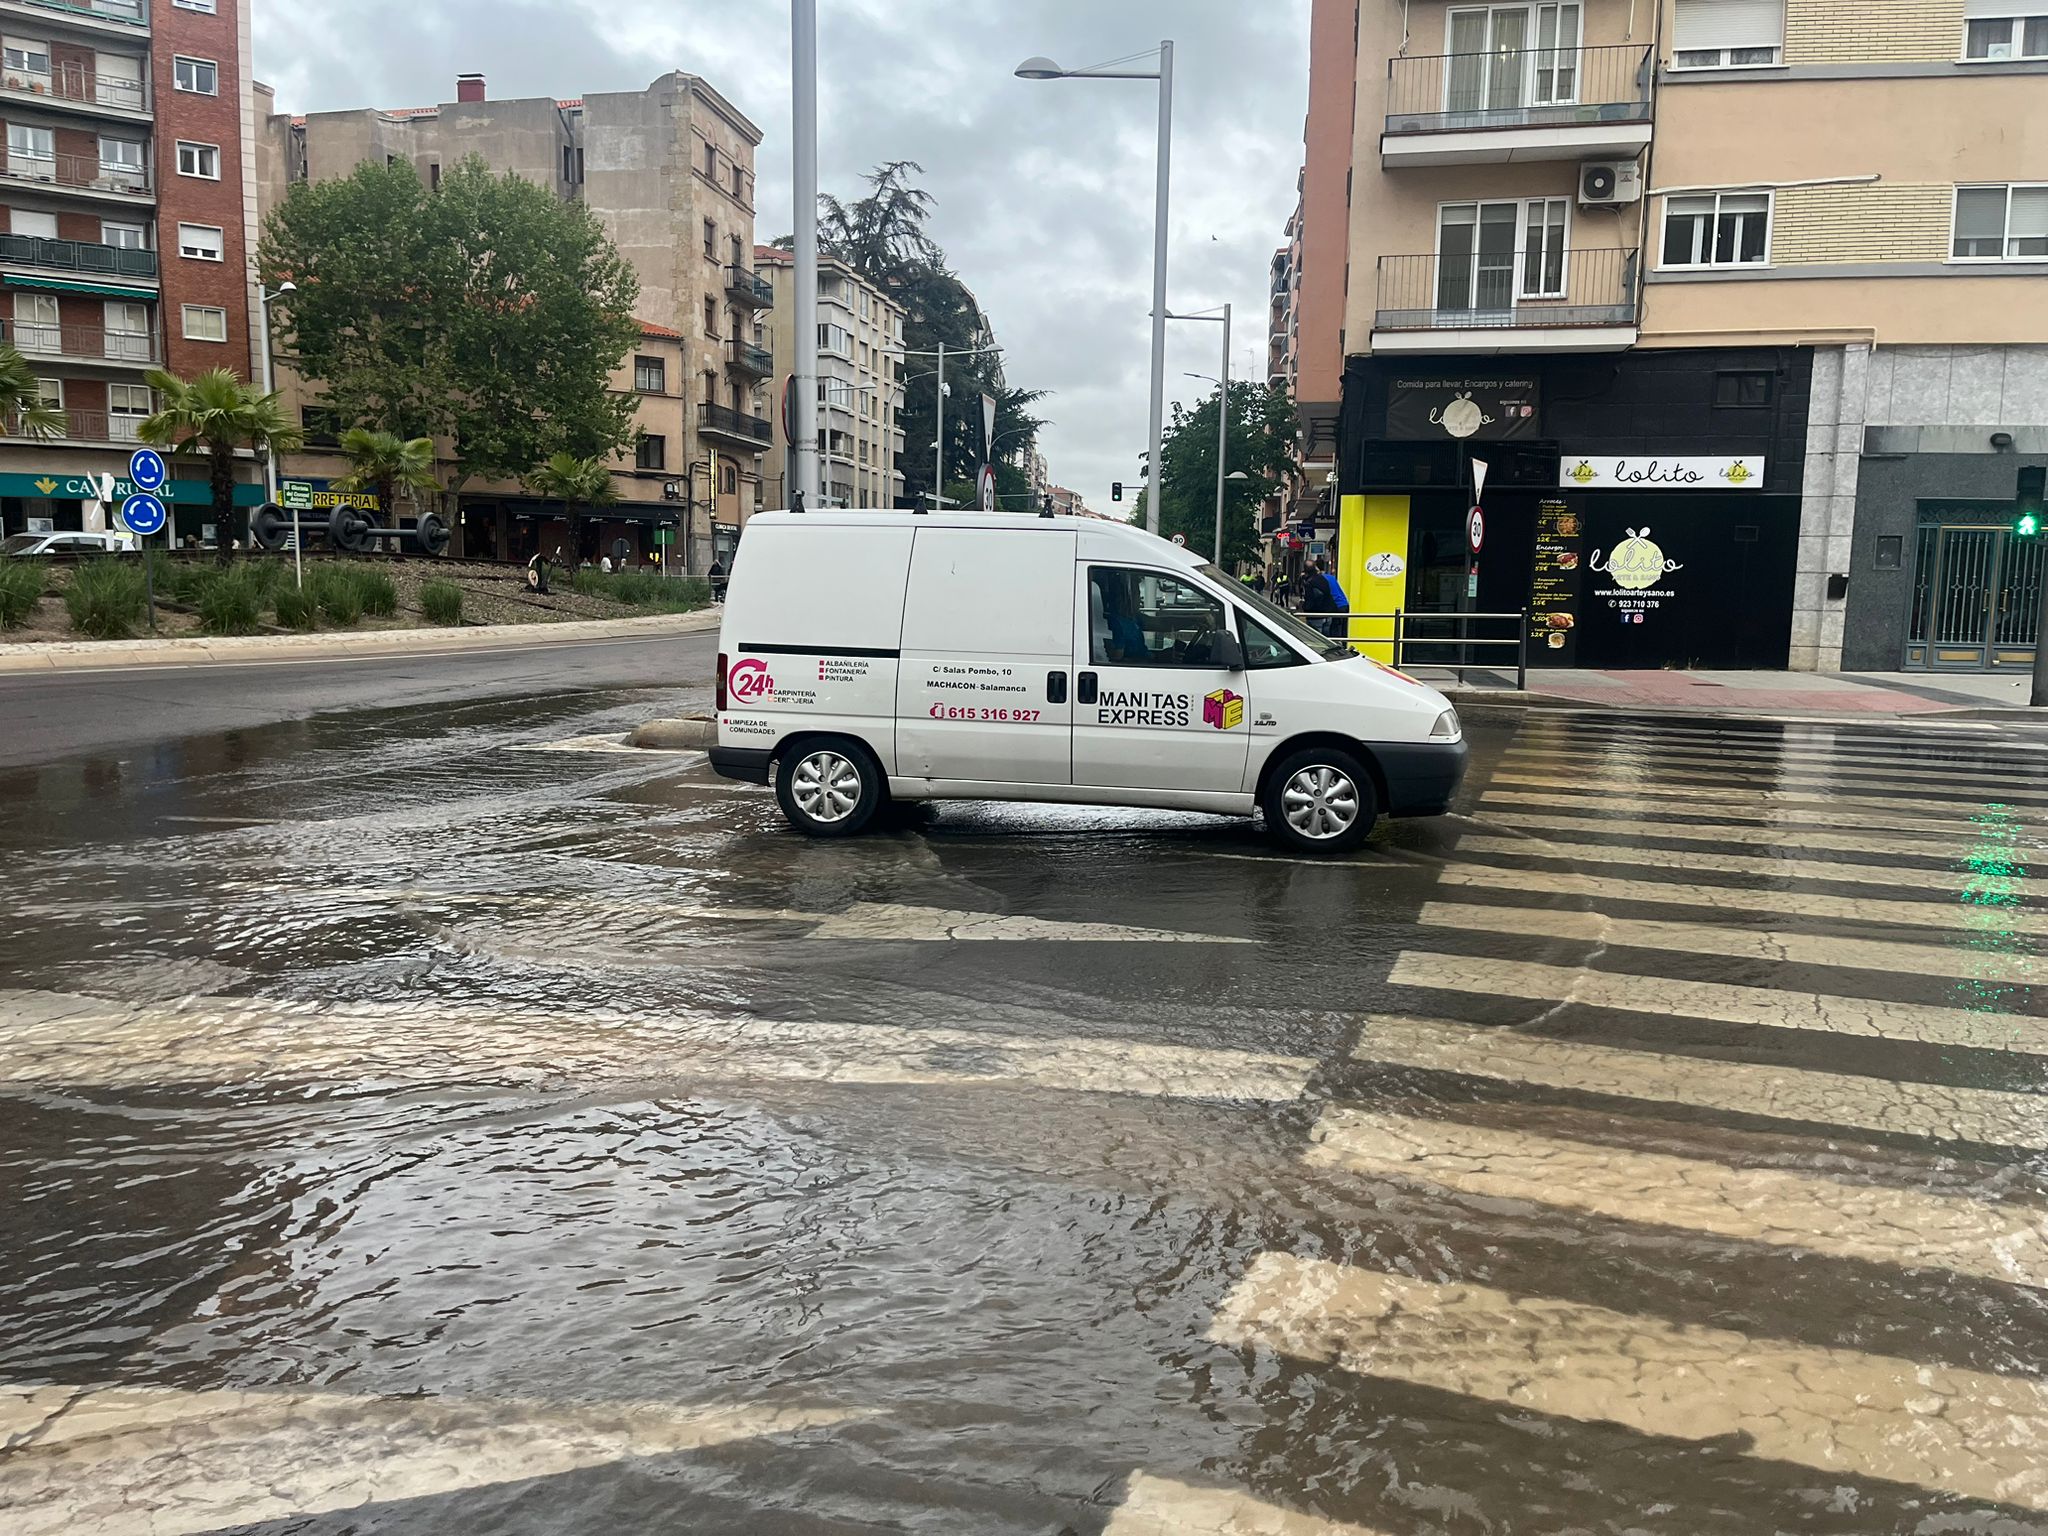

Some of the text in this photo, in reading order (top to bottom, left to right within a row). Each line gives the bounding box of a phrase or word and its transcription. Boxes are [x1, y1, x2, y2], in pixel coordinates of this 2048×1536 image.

[1397, 380, 1424, 388] Comida
[1425, 381, 1441, 390] para
[1465, 380, 1498, 389] Encargos
[1504, 380, 1534, 389] catering
[1614, 460, 1704, 483] lolito
[66, 480, 174, 498] CAJ RUAL
[1474, 522, 1482, 537] 30
[1588, 548, 1684, 572] lolito
[1366, 562, 1402, 572] lolito
[1594, 589, 1674, 598] www.lolitoarteysano.es
[826, 660, 869, 668] ALBAÑILERÍA
[968, 668, 1000, 676] Pombo,
[738, 674, 774, 696] 24h
[774, 689, 816, 698] CARPINTERÍA
[948, 707, 1040, 721] 615 316 927
[1098, 709, 1190, 726] EXPRESS
[730, 727, 776, 735] COMUNIDADES
